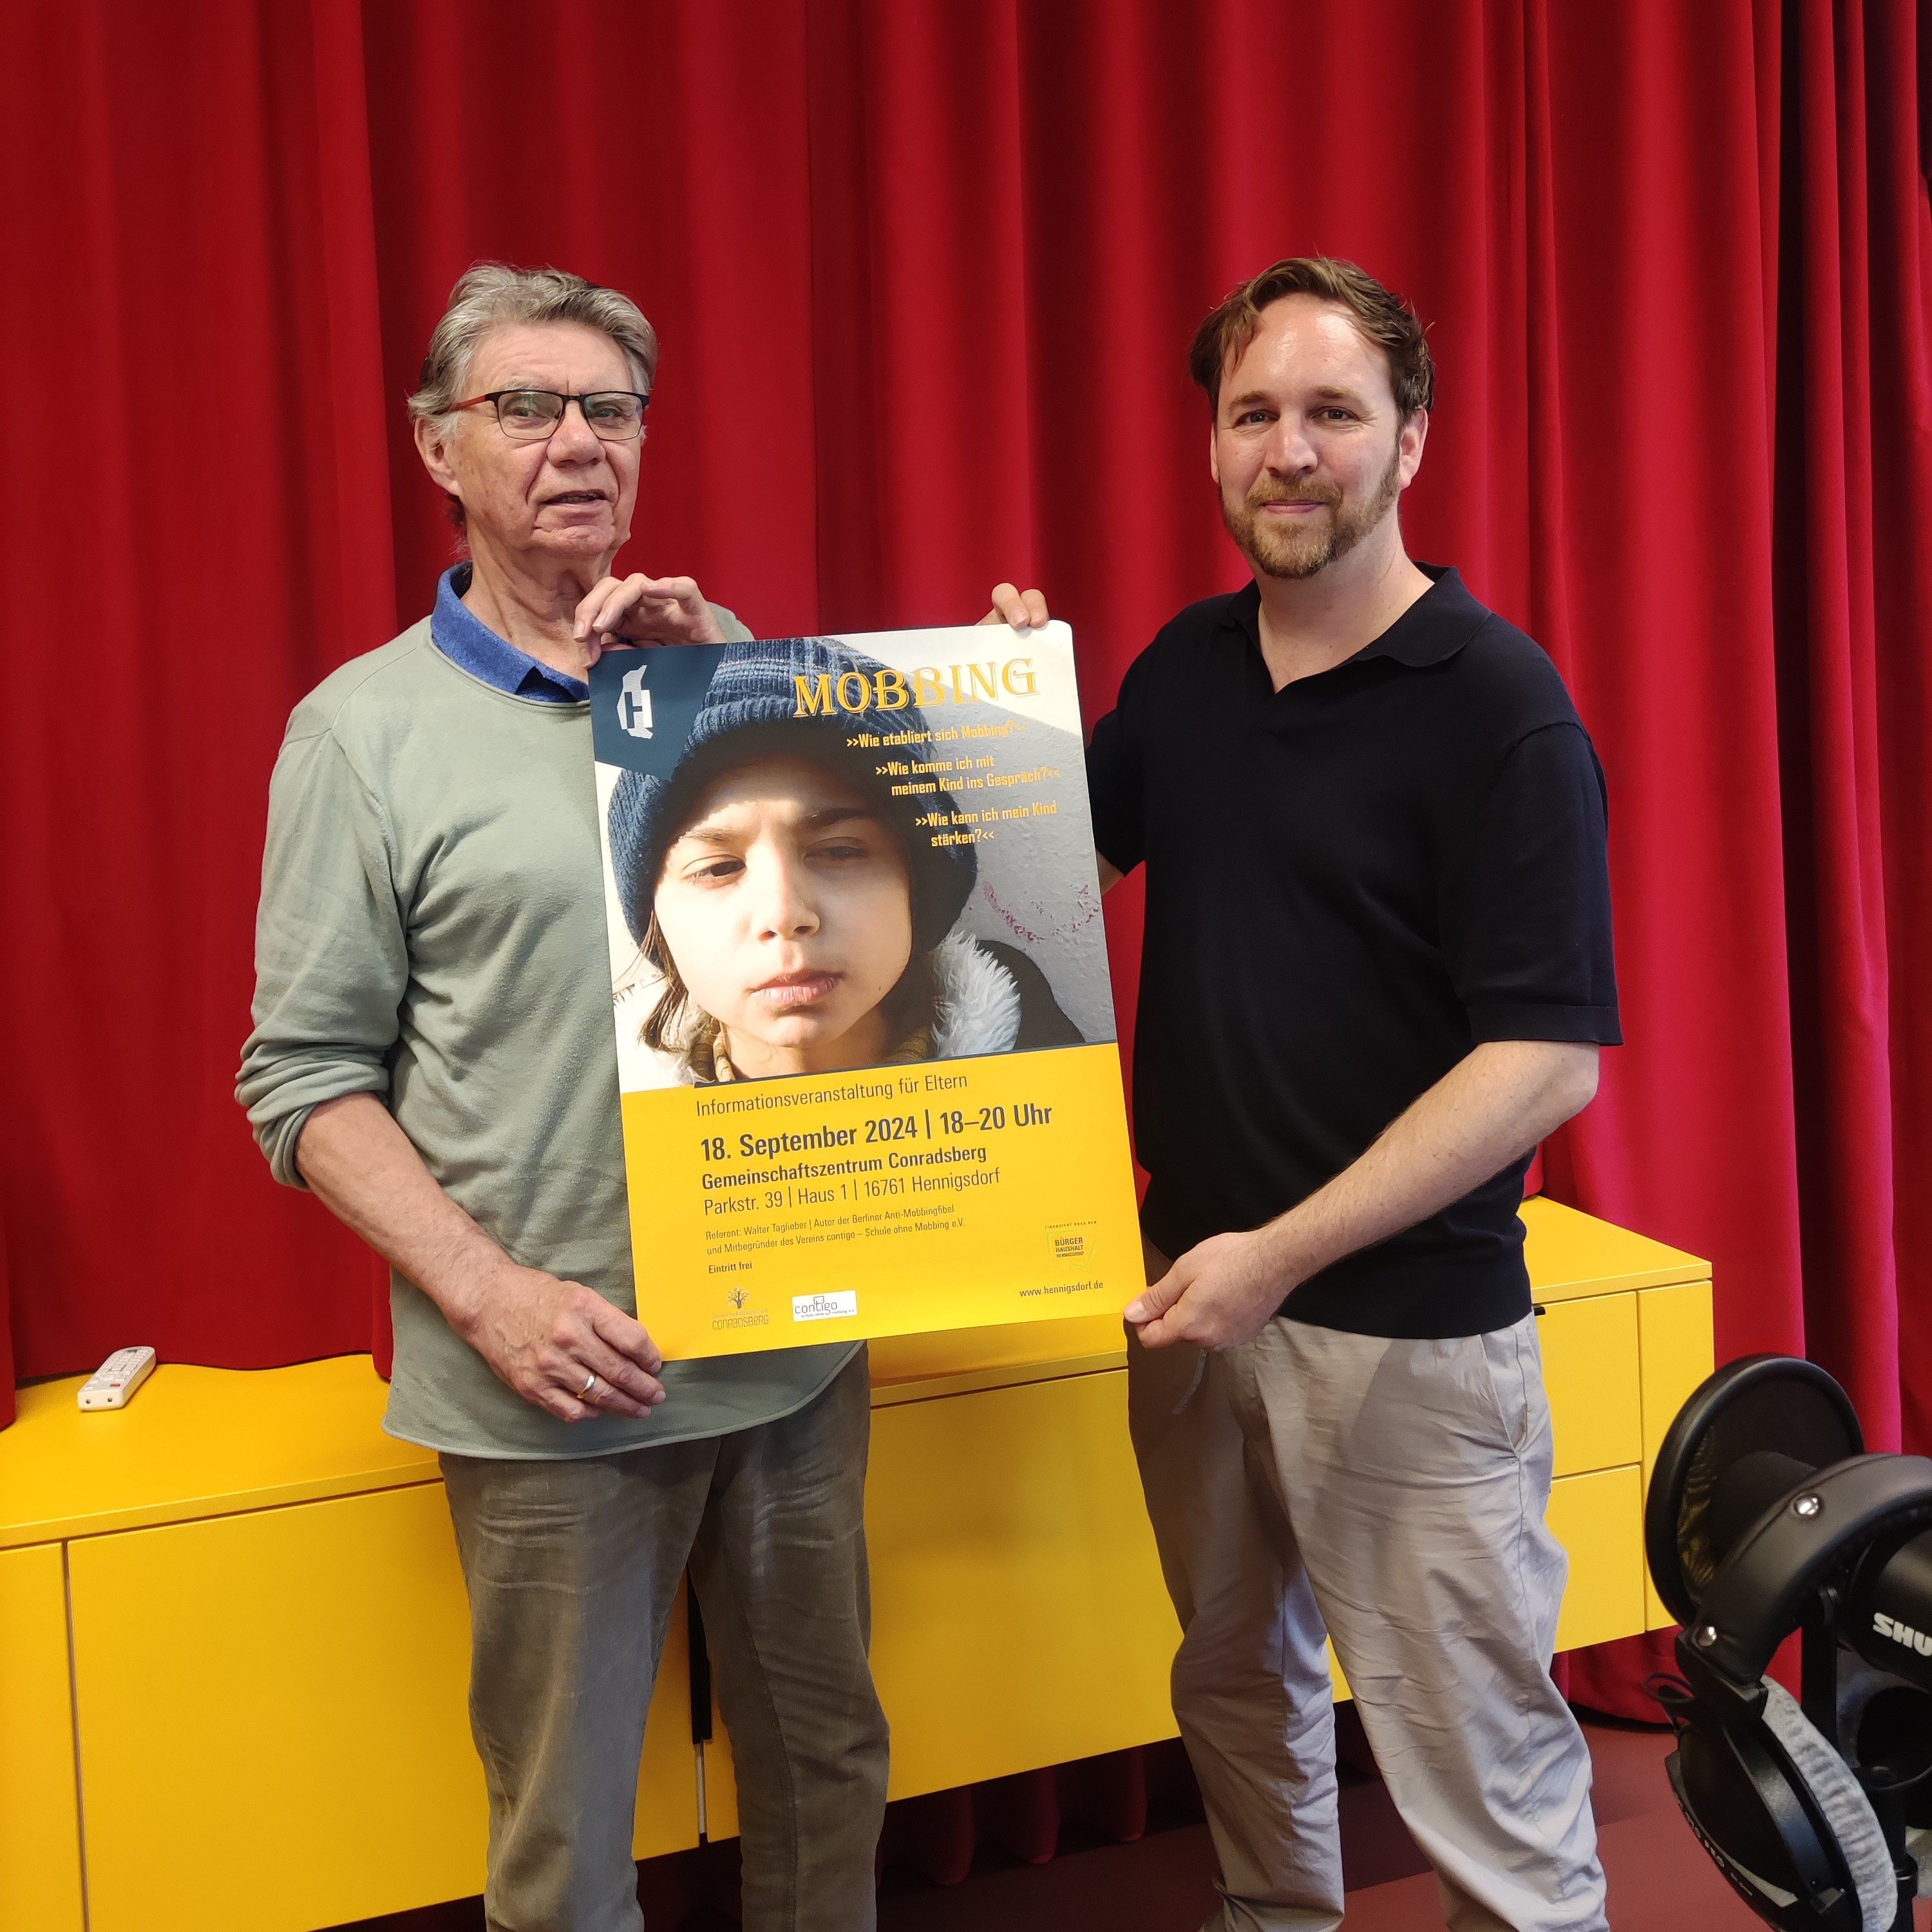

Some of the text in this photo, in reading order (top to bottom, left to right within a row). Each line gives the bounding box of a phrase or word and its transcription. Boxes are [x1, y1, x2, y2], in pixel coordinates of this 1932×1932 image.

[792, 658, 1039, 718] MOBBING
[883, 729, 933, 746] etabliert
[935, 726, 958, 741] sich
[912, 759, 952, 773] komme
[956, 756, 972, 770] ich
[976, 755, 994, 769] mit
[891, 781, 936, 796] meinem
[938, 775, 963, 791] Kind
[966, 776, 984, 790] ins
[951, 810, 979, 825] kann
[981, 808, 999, 822] ich
[1001, 804, 1030, 820] mein
[1032, 800, 1058, 817] Kind
[696, 1074, 968, 1117] Informationsveranstaltung für Eltern
[701, 1136, 732, 1161] 18.
[739, 1124, 857, 1160] September
[865, 1115, 918, 1143] 2024
[1013, 1103, 1052, 1128] Uhr
[702, 1146, 987, 1189] Gemeinschaftszentrum Conradsberg
[704, 1196, 760, 1216] Parkstr.
[764, 1190, 782, 1208] 39
[798, 1188, 835, 1205] Haus
[840, 1184, 847, 1200] 1
[863, 1177, 904, 1197] 16761
[912, 1167, 1000, 1192] Hennigsdorf
[706, 1228, 741, 1240] Referent:
[743, 1225, 770, 1236] Walter
[772, 1221, 807, 1233] Taglieber
[813, 1218, 835, 1228] Autor
[837, 1216, 849, 1225] der
[852, 1213, 882, 1224] Berliner
[884, 1204, 954, 1220] Anti-Mobbingfibel
[706, 1244, 722, 1255] und
[724, 1239, 777, 1253] Mitbegründer
[780, 1237, 794, 1246] des
[795, 1233, 824, 1244] Vereins
[826, 1230, 855, 1242] contigo
[865, 1226, 891, 1237] Schule
[893, 1224, 913, 1235] ohne
[914, 1220, 949, 1231] Mobbing
[952, 1217, 965, 1228] e.V.
[1055, 1236, 1083, 1247] BÜRGER
[1056, 1244, 1084, 1253] HAUSHALT
[708, 1260, 752, 1274] Eintritt frei
[1019, 1280, 1103, 1297] www.hennigsdorf.de
[795, 1296, 838, 1315] contigo
